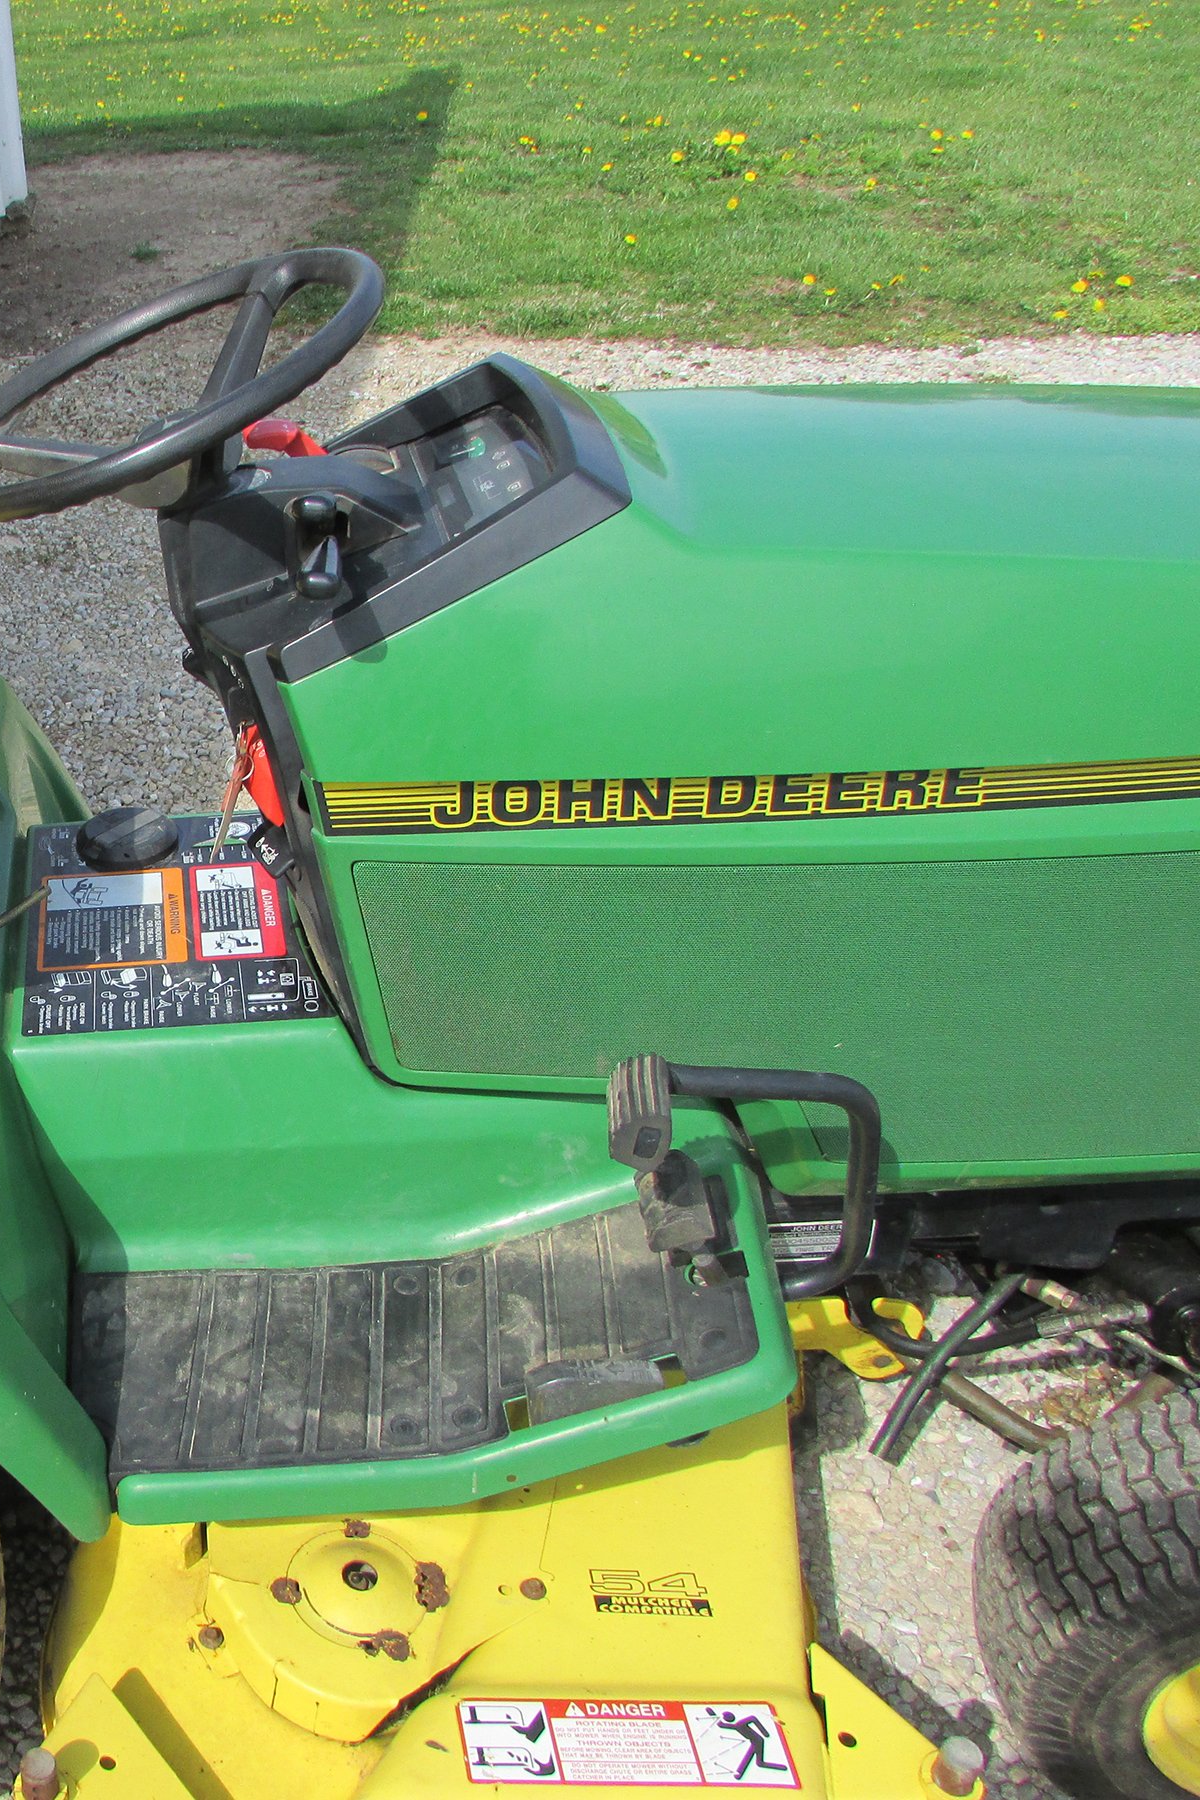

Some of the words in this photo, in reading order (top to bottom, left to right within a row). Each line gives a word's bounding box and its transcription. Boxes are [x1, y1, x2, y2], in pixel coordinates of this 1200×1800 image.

[429, 778, 672, 828] JOHN
[701, 767, 985, 818] DEERE
[169, 899, 181, 935] WARNING
[262, 896, 276, 926] DANGER
[589, 1569, 708, 1598] 54
[599, 1604, 711, 1617] COMPATIBLE
[610, 1596, 693, 1608] MULCHER
[585, 1703, 666, 1718] DANGER
